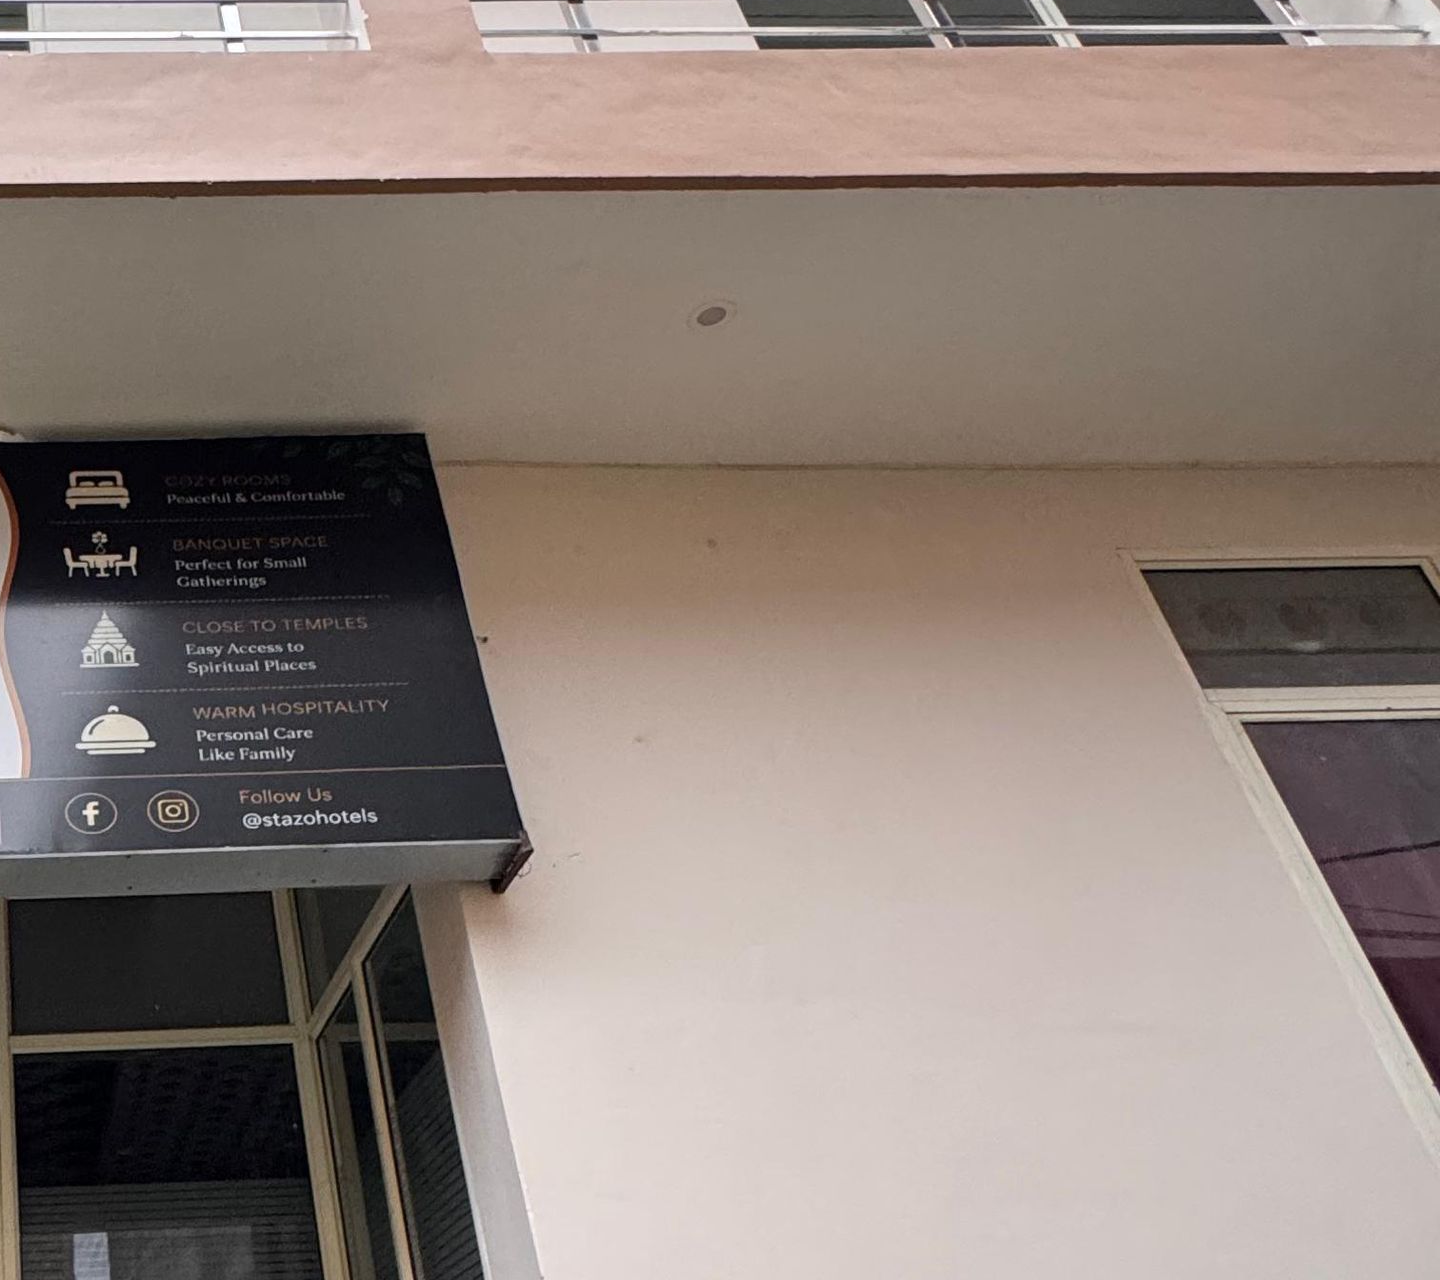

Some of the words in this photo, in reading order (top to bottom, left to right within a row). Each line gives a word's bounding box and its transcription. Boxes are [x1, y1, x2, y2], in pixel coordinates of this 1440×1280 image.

[164, 475, 215, 488] COZY
[222, 473, 292, 487] ROOMS
[167, 492, 231, 505] Peaceful
[235, 491, 247, 504] &
[250, 488, 346, 503] Comfortable
[172, 536, 263, 552] BANQUET
[269, 535, 329, 549] SPACE
[175, 558, 232, 571] Perfect
[236, 557, 260, 570] for
[263, 556, 307, 569] Small
[176, 575, 267, 589] Gatherings
[182, 619, 245, 634] CLOSE
[252, 619, 277, 632] TO
[285, 616, 369, 632] TEMPLES
[185, 642, 223, 657] Easy
[227, 641, 284, 655] Access
[287, 641, 305, 653] to
[187, 660, 260, 677] Spiritual
[264, 659, 317, 672] Places
[192, 704, 256, 720] WARM
[262, 699, 390, 716] HOSPITALITY
[196, 727, 270, 743] Personal
[273, 726, 314, 740] Care
[198, 746, 235, 762] Like
[239, 745, 296, 761] Family
[239, 787, 301, 805] Follow
[307, 786, 333, 803] Us
[242, 808, 379, 830] @stazohotels
